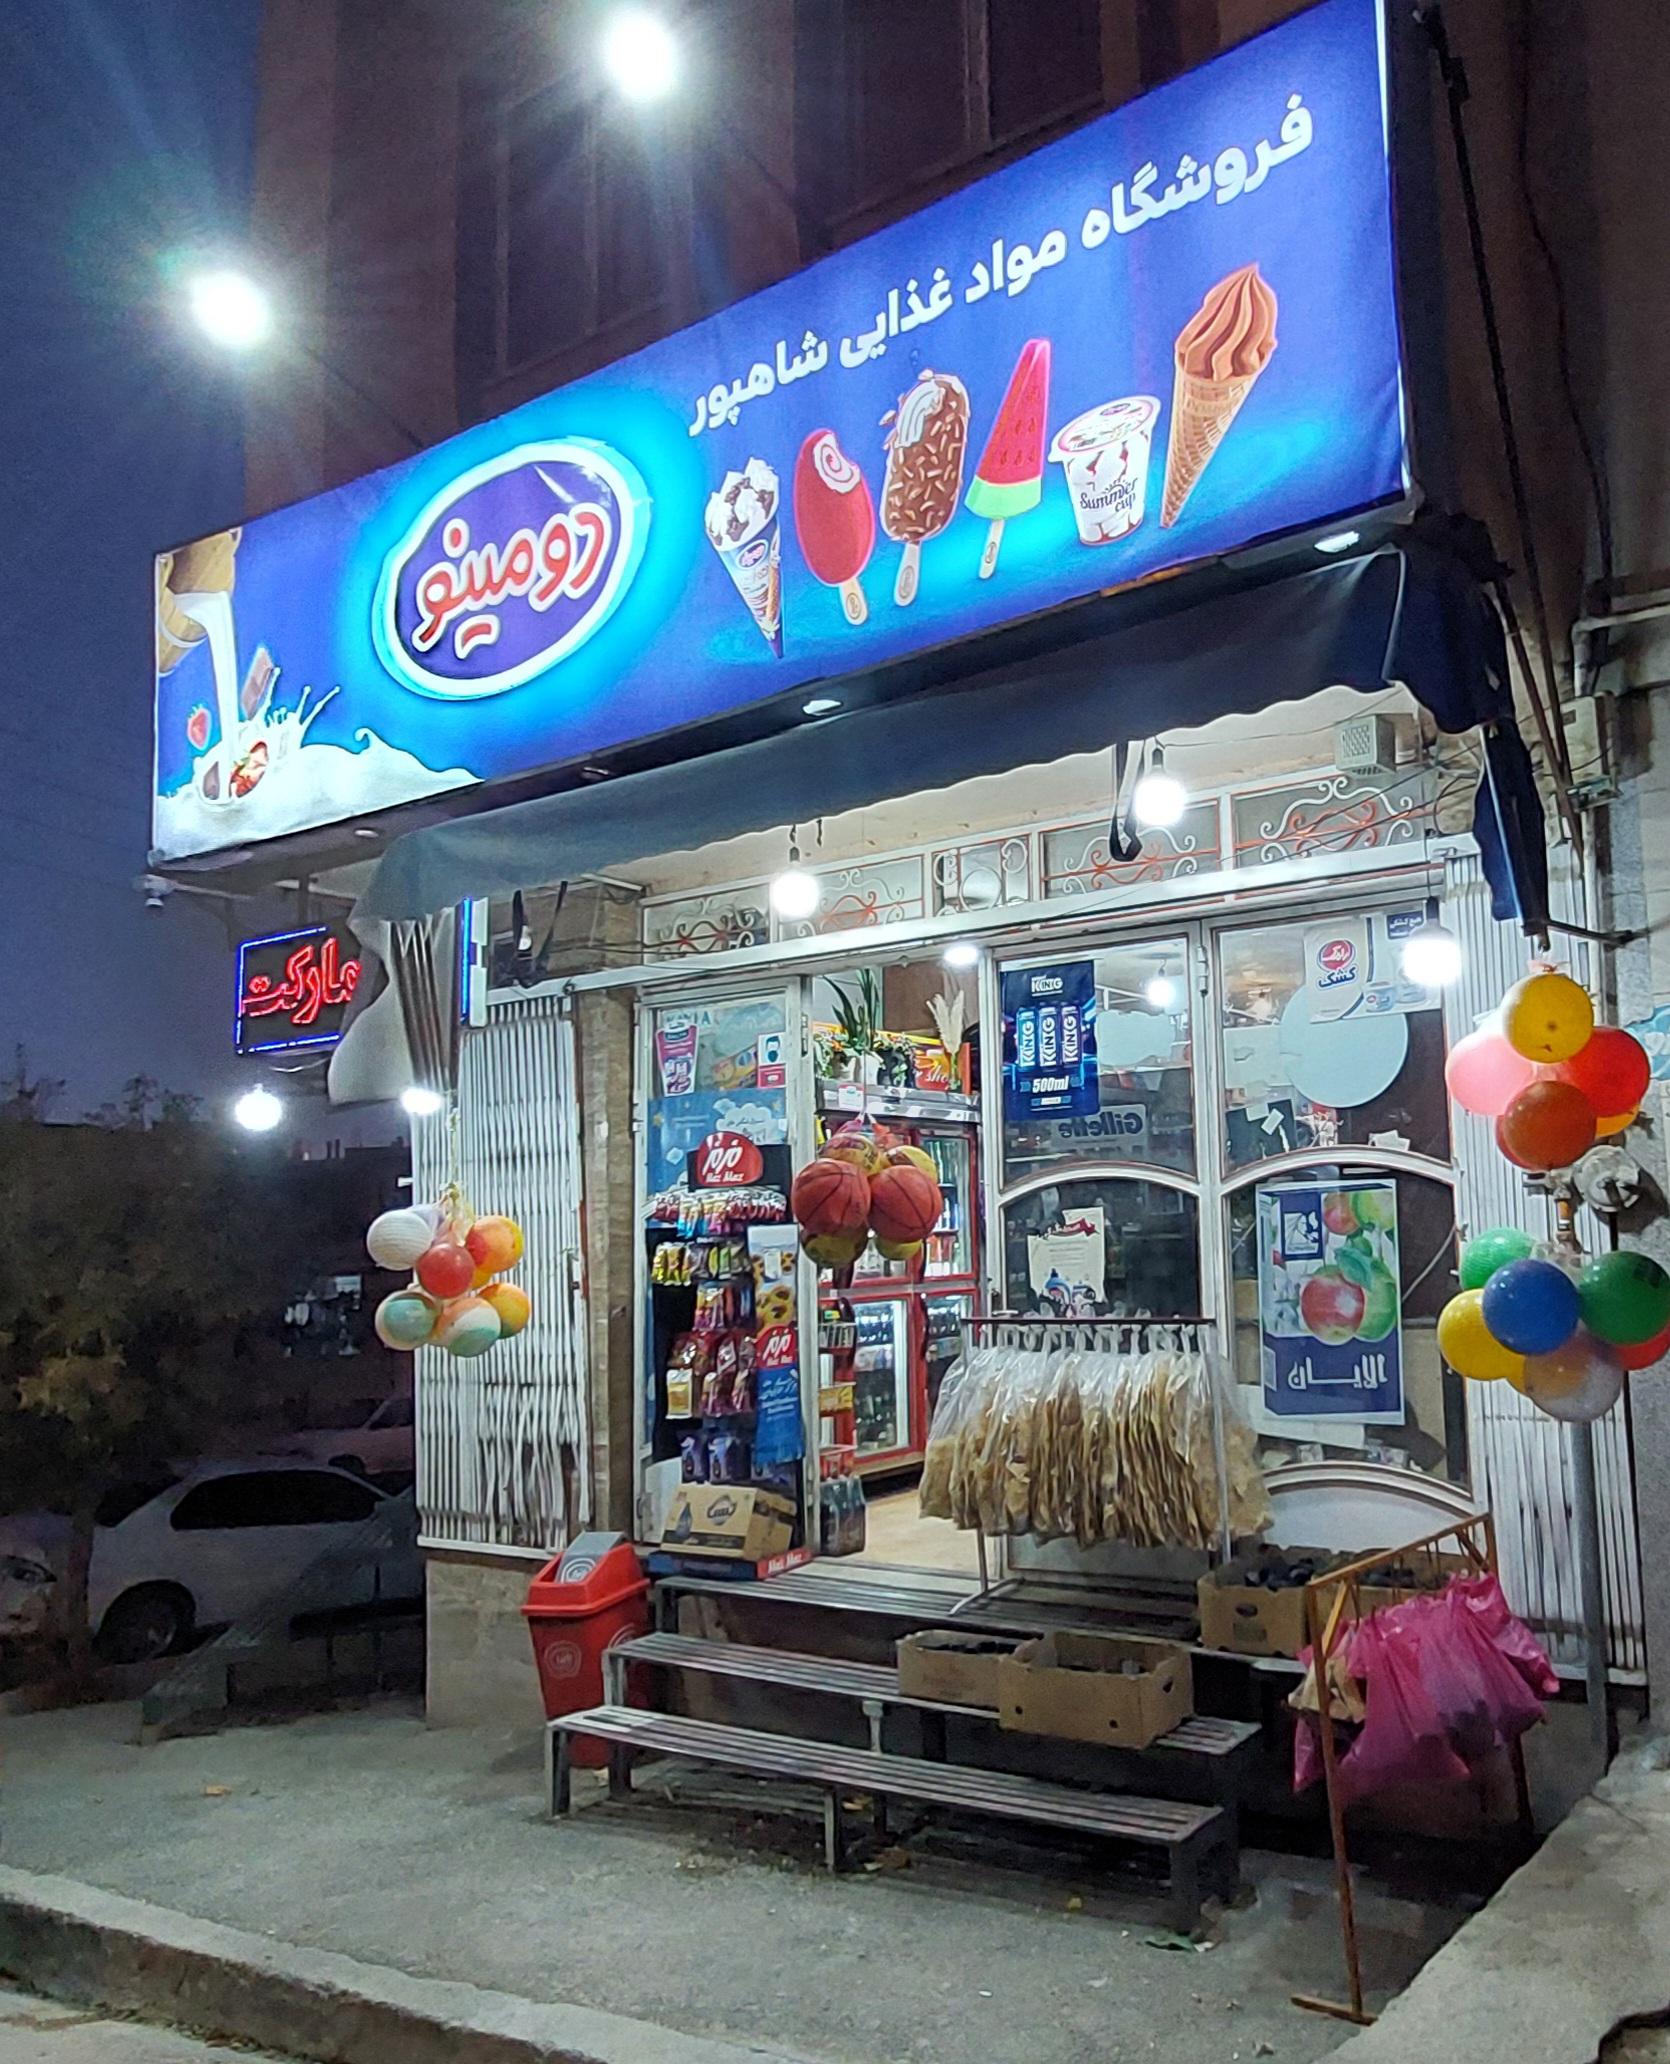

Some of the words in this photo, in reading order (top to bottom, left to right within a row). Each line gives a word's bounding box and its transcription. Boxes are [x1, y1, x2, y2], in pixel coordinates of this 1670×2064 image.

[1081, 93, 1313, 249] فروشگاه
[965, 229, 1068, 304] مواد
[839, 266, 953, 369] غذایی
[688, 329, 829, 438] شاهپور
[1079, 477, 1138, 510] Summer
[1114, 493, 1137, 512] cup
[410, 501, 615, 659] دومینو
[240, 936, 362, 1025] مارکت
[1031, 975, 1064, 993] KING
[1318, 966, 1357, 988] کشک
[1020, 1020, 1036, 1068] KING
[1039, 1016, 1057, 1068] KING
[1062, 1015, 1079, 1063] KING
[1032, 1075, 1069, 1094] 500ml
